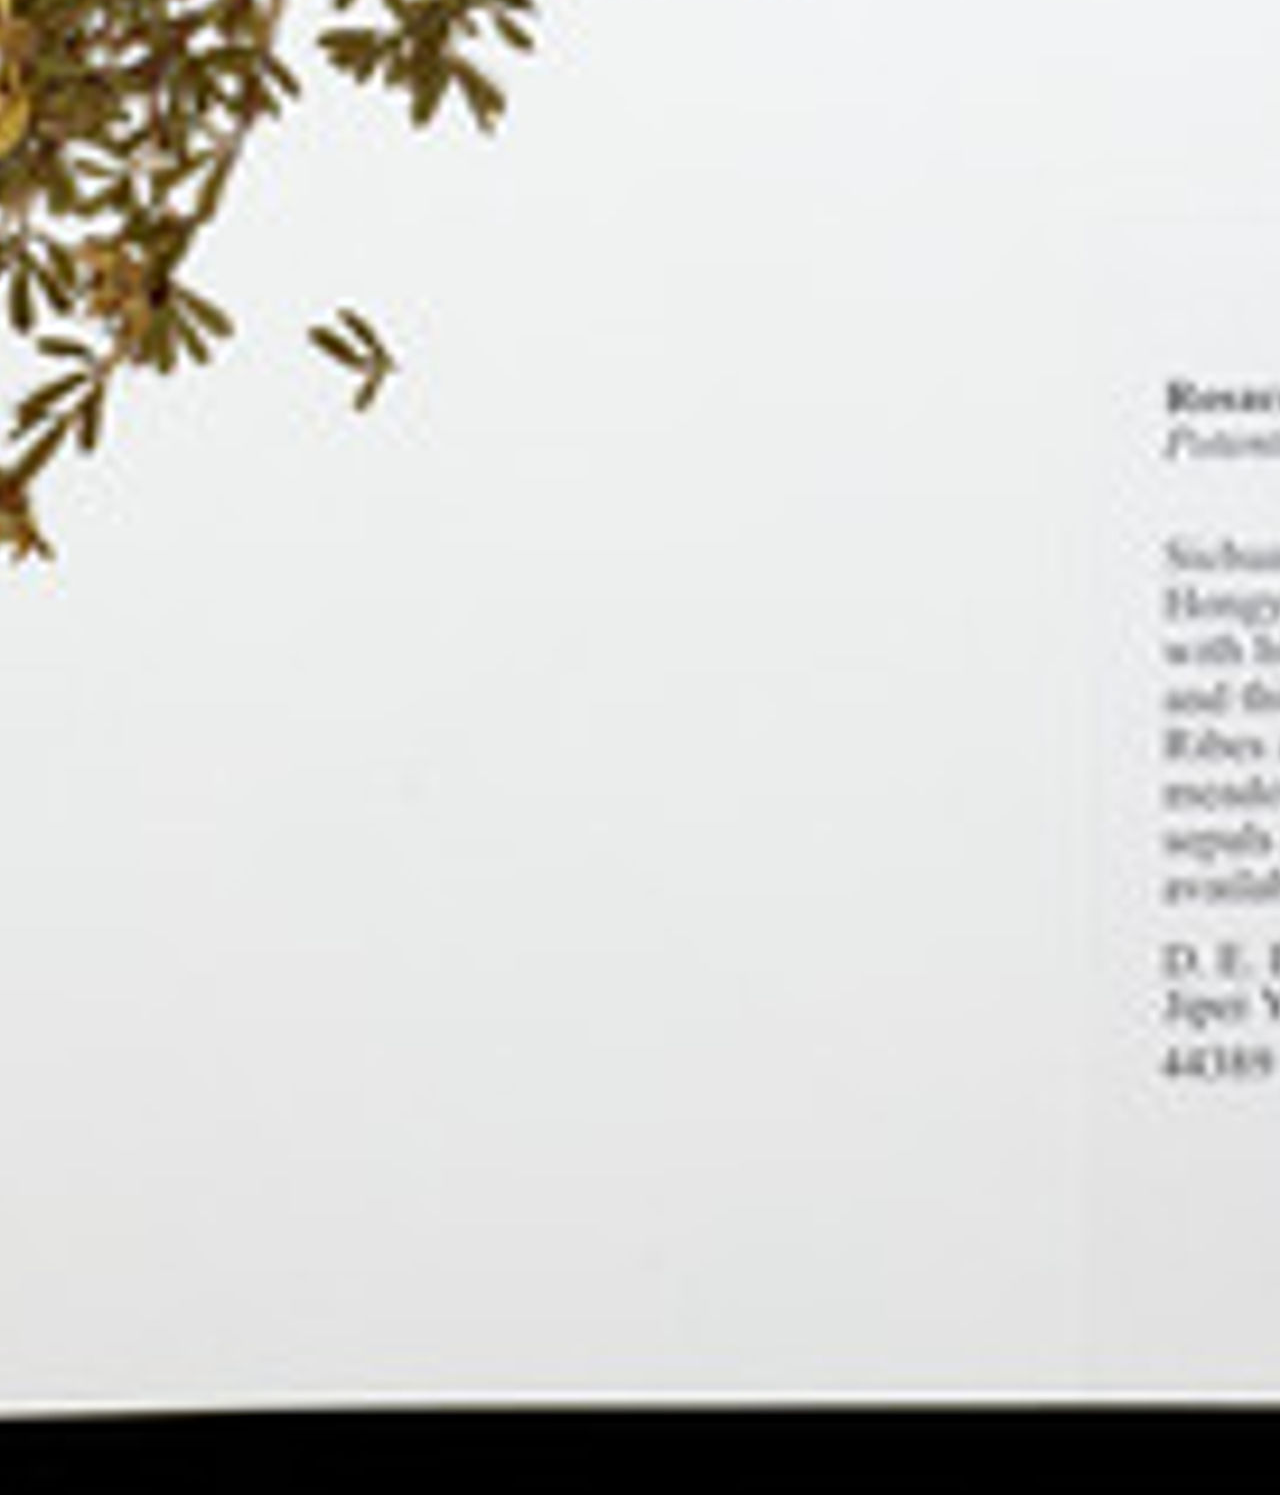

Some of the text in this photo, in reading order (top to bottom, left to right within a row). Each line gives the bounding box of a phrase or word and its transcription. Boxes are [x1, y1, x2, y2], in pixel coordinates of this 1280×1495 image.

[1165, 627, 1243, 663] with
[1165, 673, 1230, 710] and
[1165, 722, 1265, 759] Ribes
[1164, 816, 1273, 858] sepals
